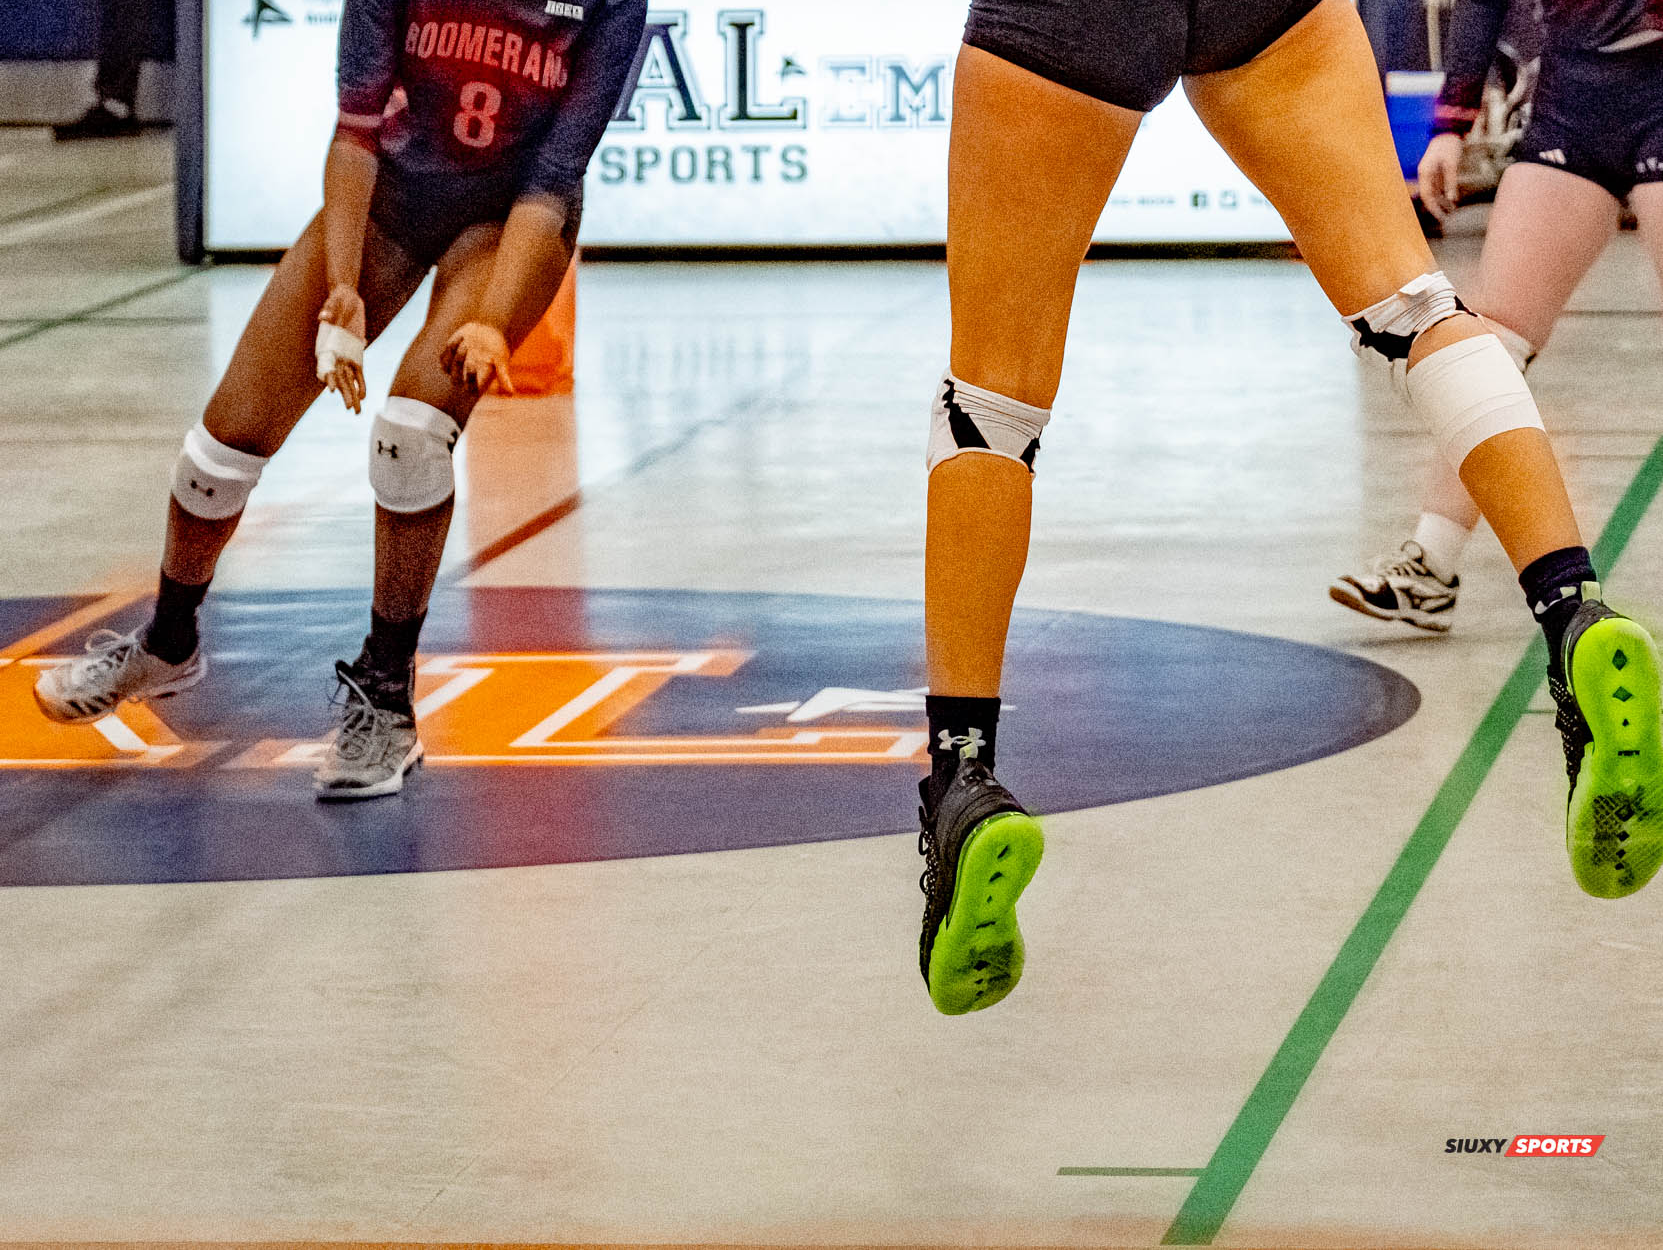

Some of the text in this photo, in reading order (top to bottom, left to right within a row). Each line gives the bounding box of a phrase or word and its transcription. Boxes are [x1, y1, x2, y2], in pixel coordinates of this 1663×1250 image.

[608, 9, 807, 130] AL
[453, 81, 502, 148] 8
[598, 144, 809, 184] SPORTS
